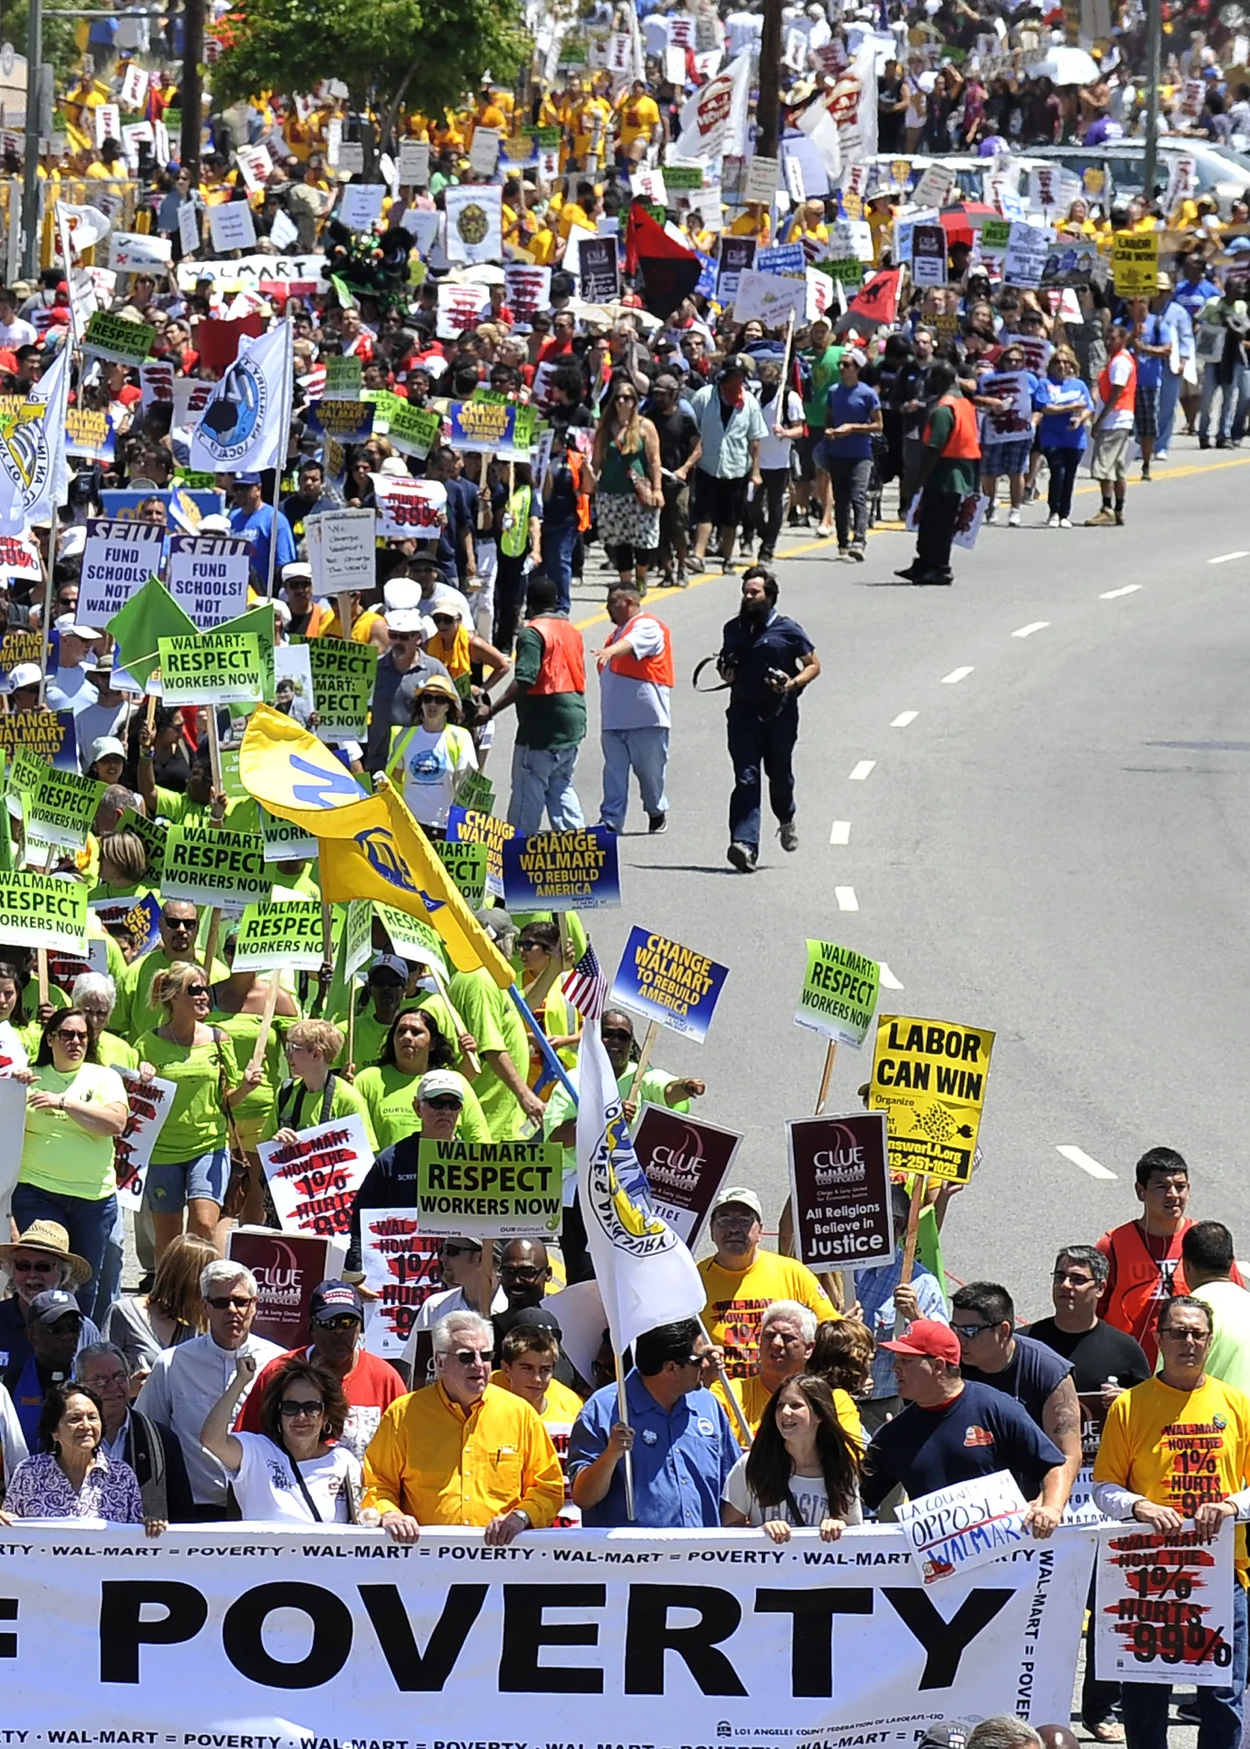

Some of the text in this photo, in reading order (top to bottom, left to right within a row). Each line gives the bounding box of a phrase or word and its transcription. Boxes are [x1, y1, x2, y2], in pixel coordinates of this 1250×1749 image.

[1119, 239, 1150, 250] LABOR
[1114, 251, 1132, 263] CAN
[194, 261, 305, 280] WALMART
[92, 323, 149, 348] RESPECT
[86, 336, 149, 360] WORKERS NOW
[461, 402, 507, 416] CHANGE
[394, 411, 433, 436] RESPECT
[457, 414, 516, 429] WALMART
[95, 522, 160, 541] SEIU
[105, 548, 139, 563] FUND
[87, 565, 152, 582] SCHOOLS!
[105, 585, 131, 598] NOT
[170, 633, 245, 649] WALMART:
[168, 650, 252, 672] RESPECT
[164, 672, 258, 690] WORKERS NOW
[647, 935, 712, 976] CHANGE
[820, 942, 875, 978] WALMART:
[635, 946, 713, 991] WALMART
[636, 967, 700, 1005] TO REBUILD
[810, 964, 876, 1006] RESPECT
[638, 985, 689, 1017] AMERICA
[801, 989, 871, 1030] WORKERS NOW
[888, 1023, 981, 1062] LABOR
[877, 1059, 982, 1100] CAN WIN
[875, 1095, 914, 1106] Organize
[436, 1141, 545, 1163] WALMART:
[814, 1147, 864, 1168] CLUE
[428, 1165, 552, 1192] RESPECT
[420, 1196, 559, 1215] WORKERS NOW
[806, 1203, 880, 1220] All Religions
[814, 1218, 874, 1235] Believe in
[808, 1234, 883, 1257] Justice
[1118, 1551, 1201, 1567] HOW THE
[1138, 1567, 1192, 1600] 1%
[1028, 1549, 1054, 1641] WAL-MART
[1118, 1601, 1202, 1627] HURTS
[99, 1579, 1018, 1697] POVERTY
[1133, 1625, 1232, 1667] 99%
[47, 1731, 159, 1744] WAL-MART
